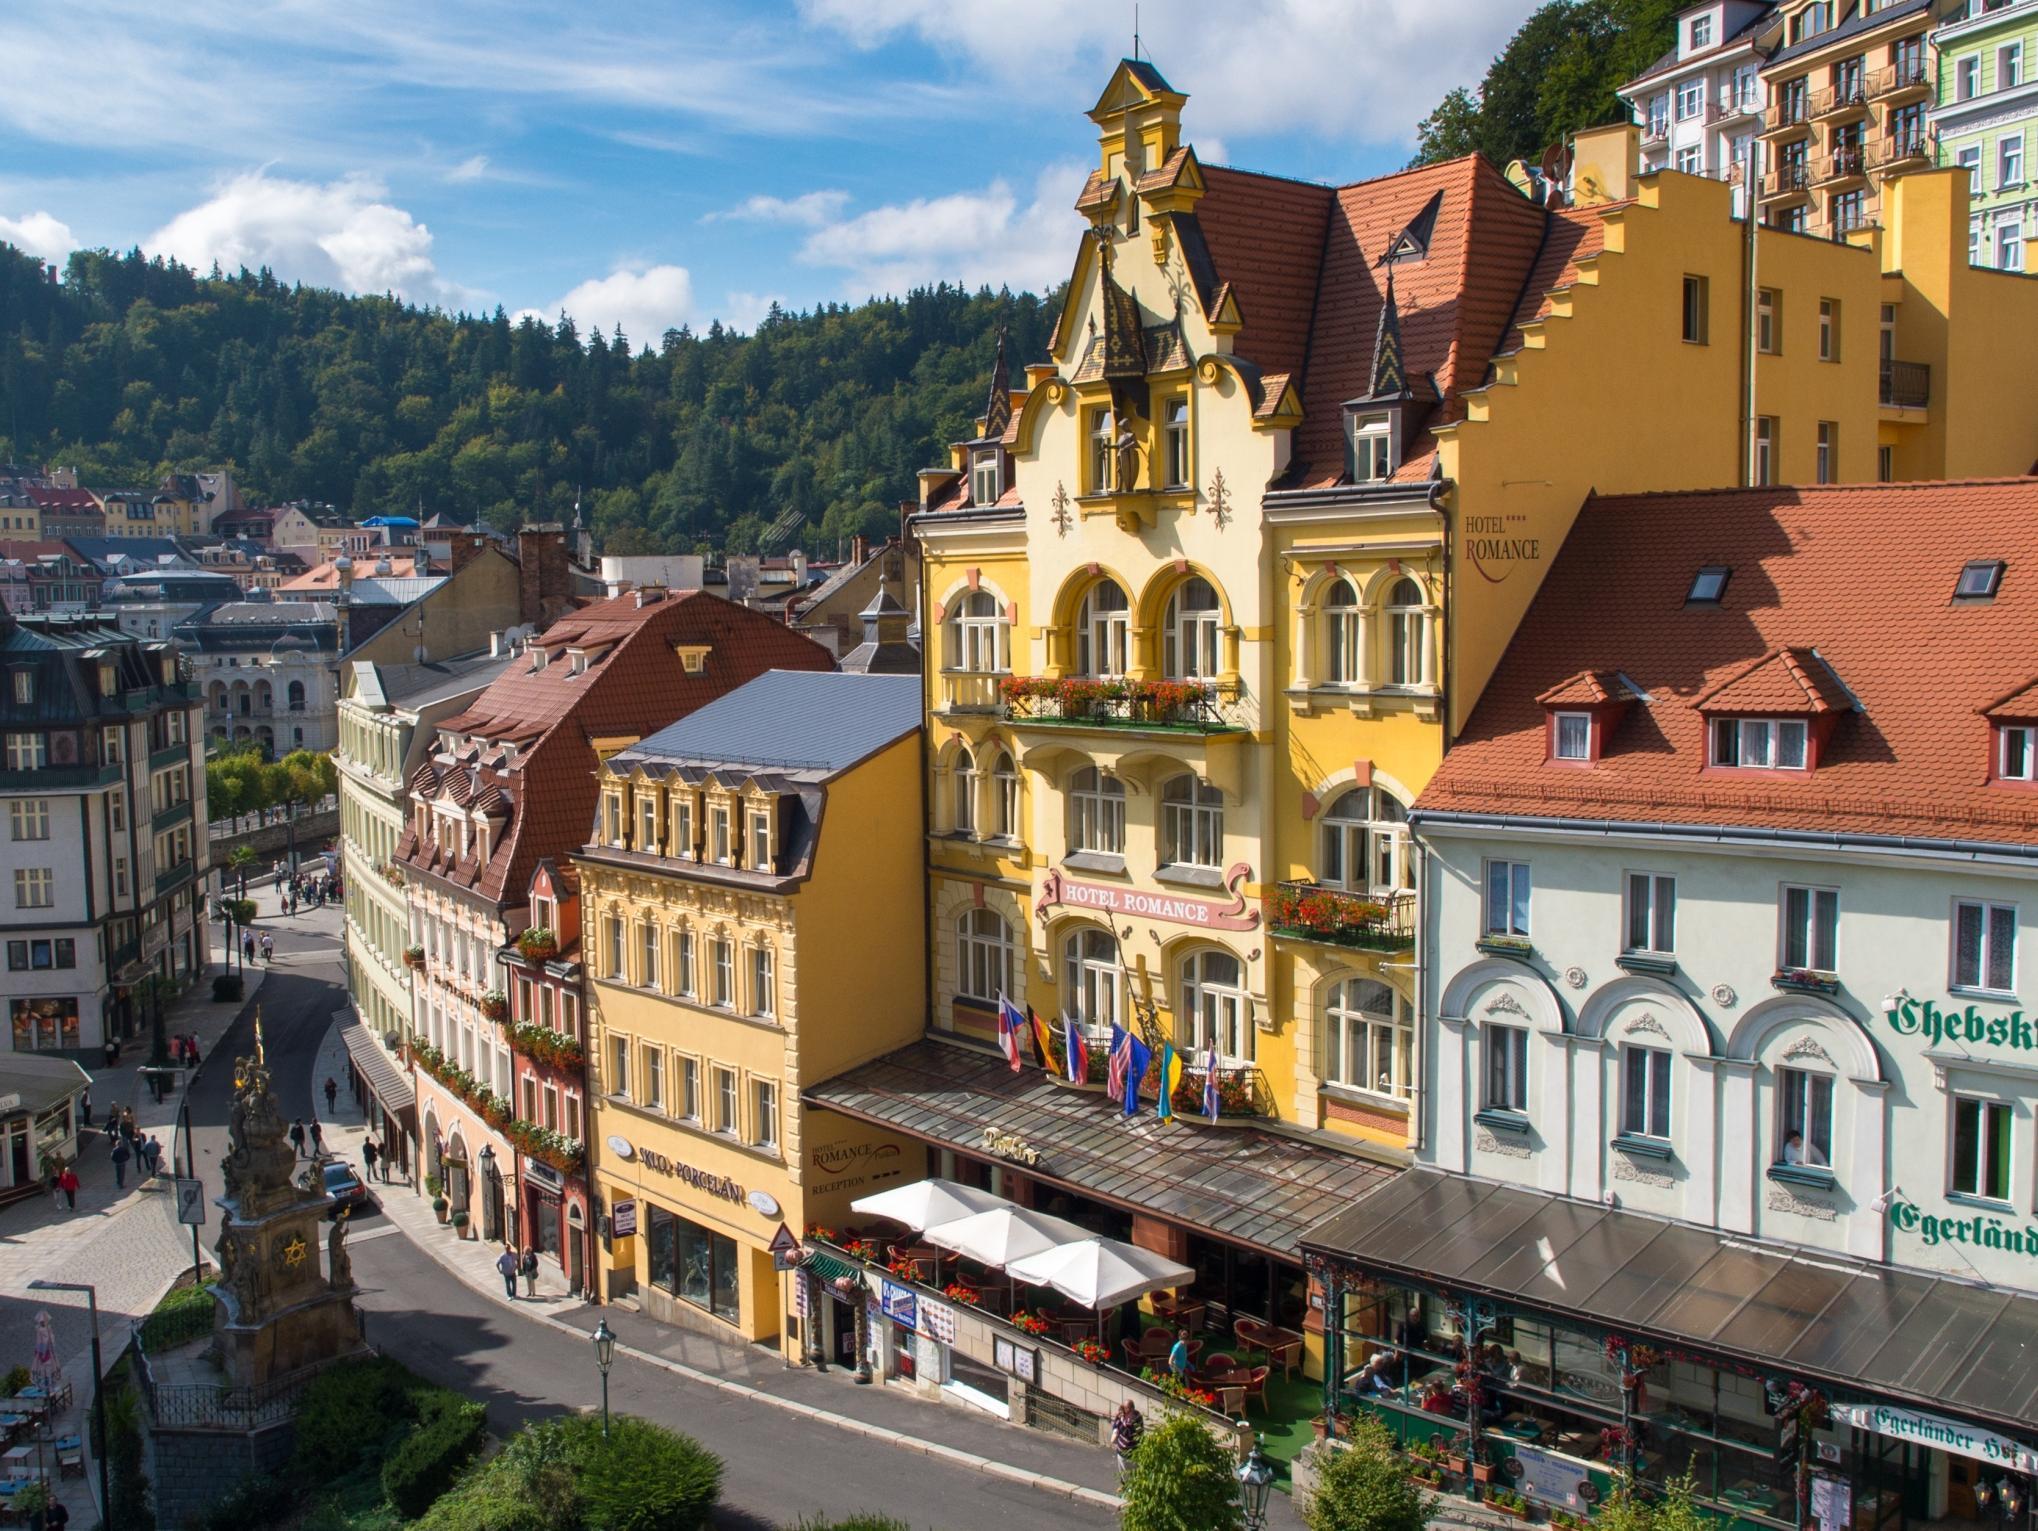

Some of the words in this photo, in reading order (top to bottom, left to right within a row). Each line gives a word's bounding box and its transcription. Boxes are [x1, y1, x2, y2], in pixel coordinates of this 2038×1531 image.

[1465, 516, 1505, 533] HOTEL
[1465, 539, 1540, 560] ROMANCE
[1065, 885, 1119, 908] HOTEL
[1123, 893, 1209, 922] ROMANCE
[1887, 996, 2038, 1050] Chebsk
[639, 1147, 667, 1172] SKLO
[812, 1144, 872, 1166] ROMANCE
[813, 1145, 834, 1155] HOTEL
[812, 1175, 865, 1196] RECEPTION
[1873, 1406, 1974, 1449] Egerländer
